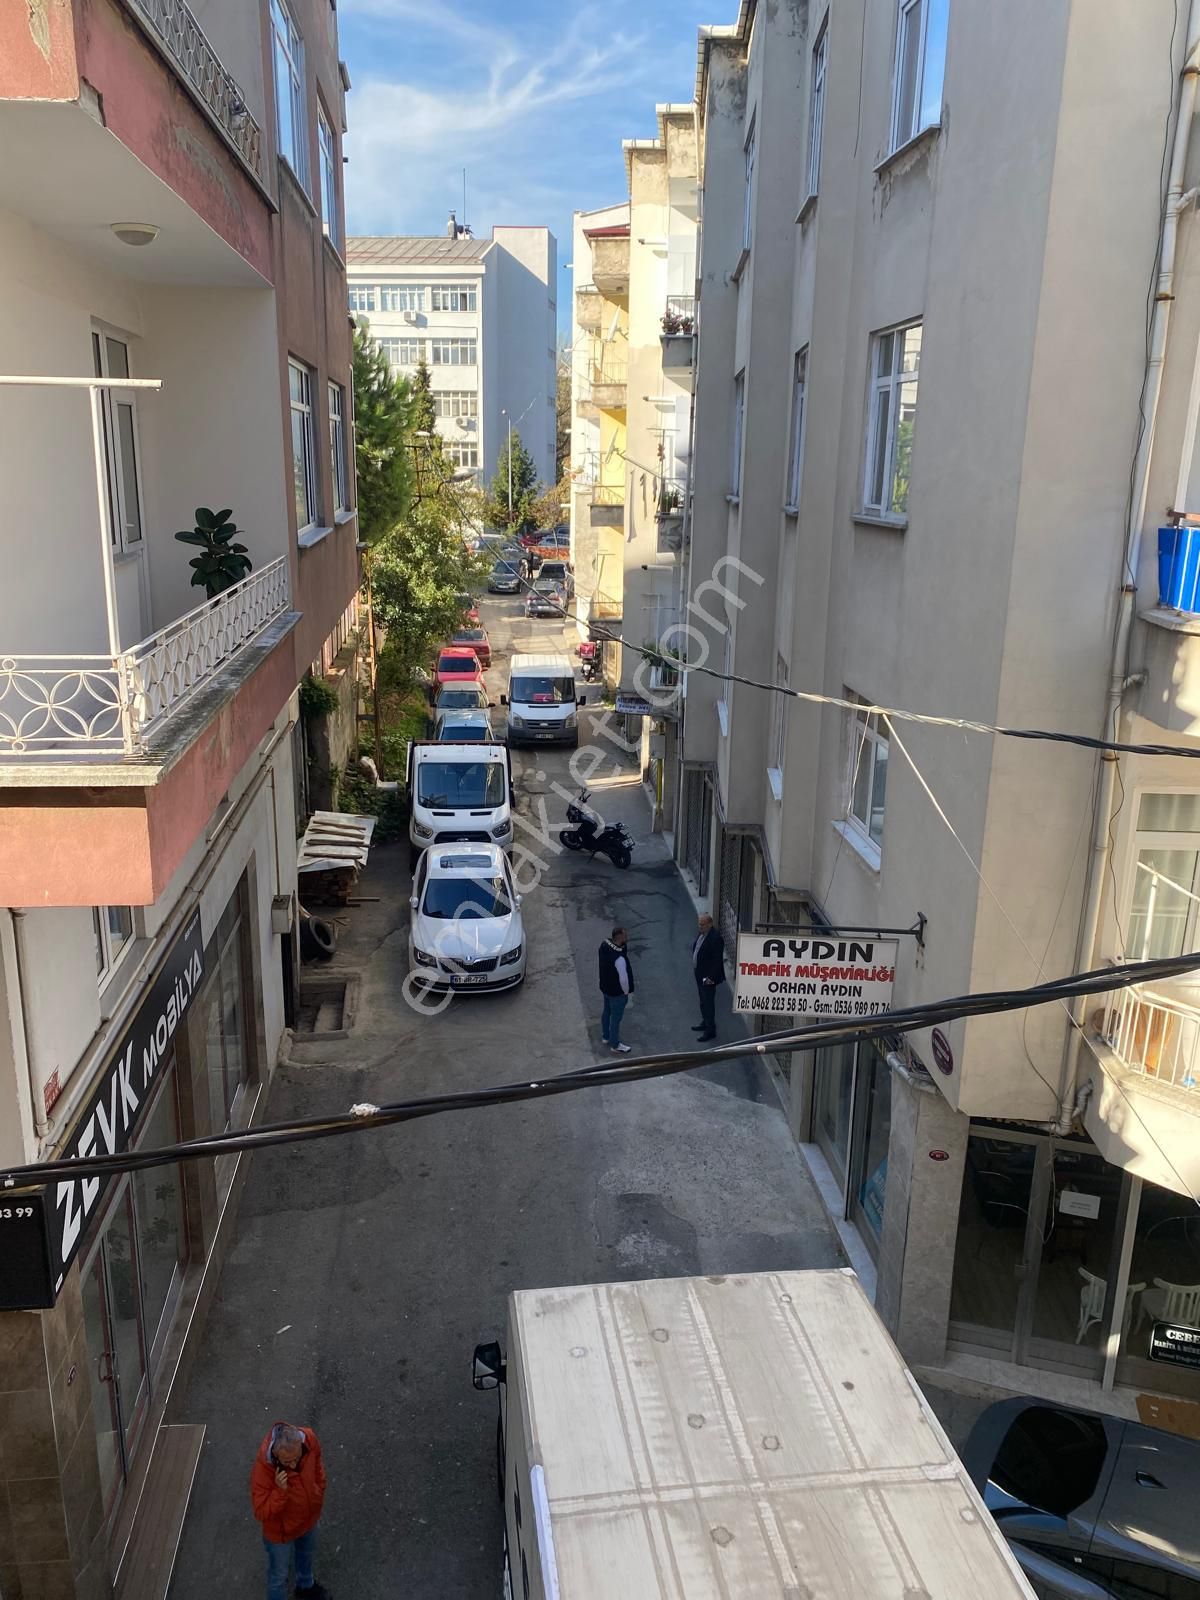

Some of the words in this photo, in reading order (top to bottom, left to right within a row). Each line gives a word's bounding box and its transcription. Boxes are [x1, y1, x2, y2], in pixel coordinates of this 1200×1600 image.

[763, 939, 874, 963] AYDIN
[739, 961, 792, 977] TRAFİK
[795, 963, 895, 983] MÜŞAVİRLİĞİ
[768, 981, 817, 996] ORHAN
[820, 983, 862, 998] AYDIN
[737, 995, 750, 1010] Tel:
[751, 996, 769, 1011] 0462
[771, 997, 785, 1012] 223
[787, 997, 797, 1012] 58
[798, 998, 807, 1012] 50
[814, 999, 833, 1014] Gsm:
[834, 1000, 852, 1015] 0536
[854, 1001, 868, 1015] 989
[870, 1002, 880, 1016] 97
[56, 1040, 139, 1263] ZEVK
[143, 949, 202, 1089] MOBİLYA
[0, 1208, 12, 1219] 3
[15, 1207, 34, 1218] 99
